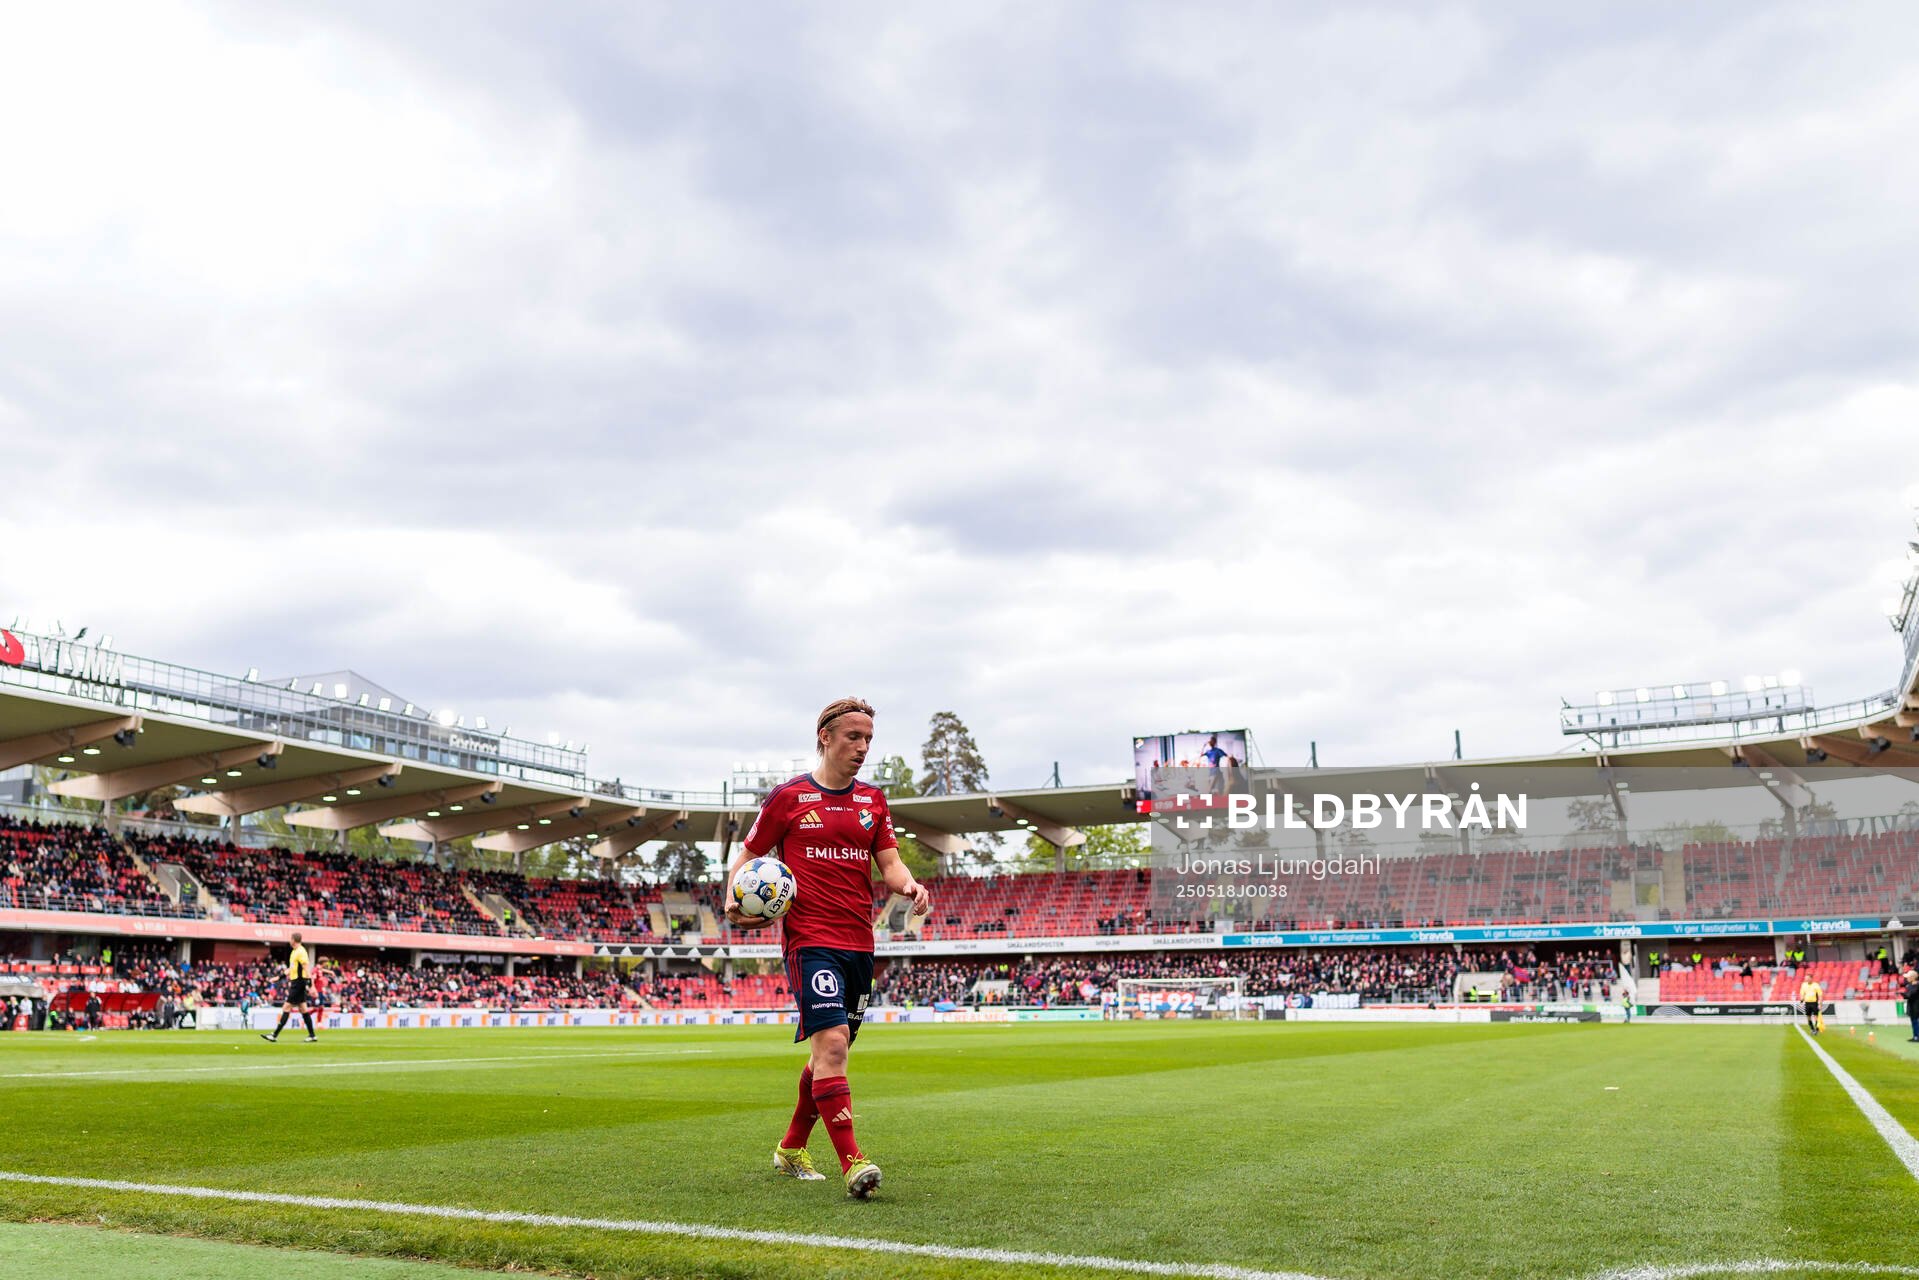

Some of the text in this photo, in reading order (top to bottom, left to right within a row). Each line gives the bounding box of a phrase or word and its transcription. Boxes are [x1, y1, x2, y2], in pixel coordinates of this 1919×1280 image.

[37, 637, 127, 687] VISMA
[68, 680, 126, 707] ARENA
[769, 882, 790, 914] SELECT
[1810, 919, 1850, 930] bravida
[1419, 931, 1454, 941] bravida
[1603, 926, 1641, 936] bravida
[1152, 937, 1215, 945] SMÅLANDSPOSTEN
[1251, 935, 1284, 945] bravida
[1138, 992, 1195, 1011] EF 92
